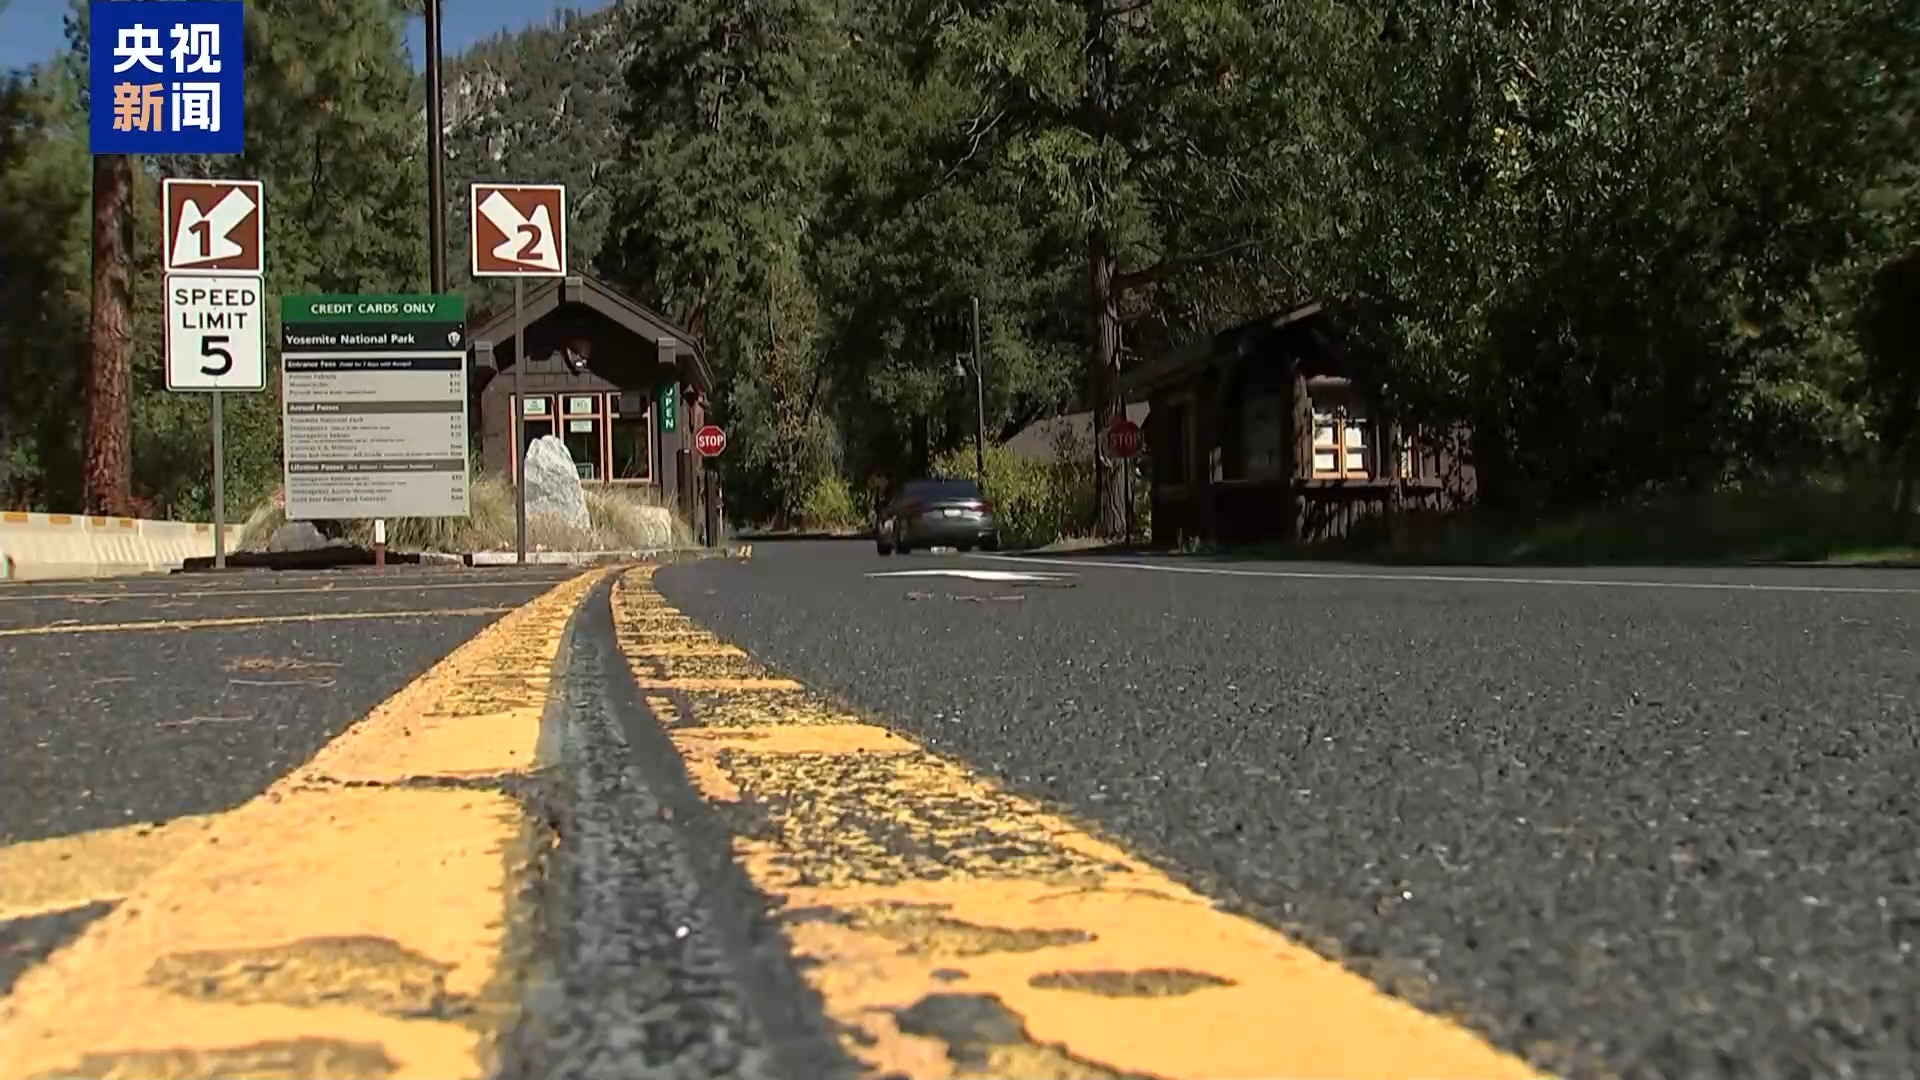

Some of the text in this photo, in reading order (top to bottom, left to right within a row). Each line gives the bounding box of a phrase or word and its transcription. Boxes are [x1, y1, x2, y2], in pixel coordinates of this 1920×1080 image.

[188, 220, 211, 257] 1
[516, 224, 544, 260] 2
[175, 288, 256, 306] SPEED
[310, 303, 436, 314] CREDIT CARDS ONLY
[182, 312, 248, 329] LIMIT
[285, 333, 415, 345] Yosemite National Park
[200, 335, 233, 376] 5
[665, 387, 674, 429] OPEN
[698, 435, 724, 448] STOP
